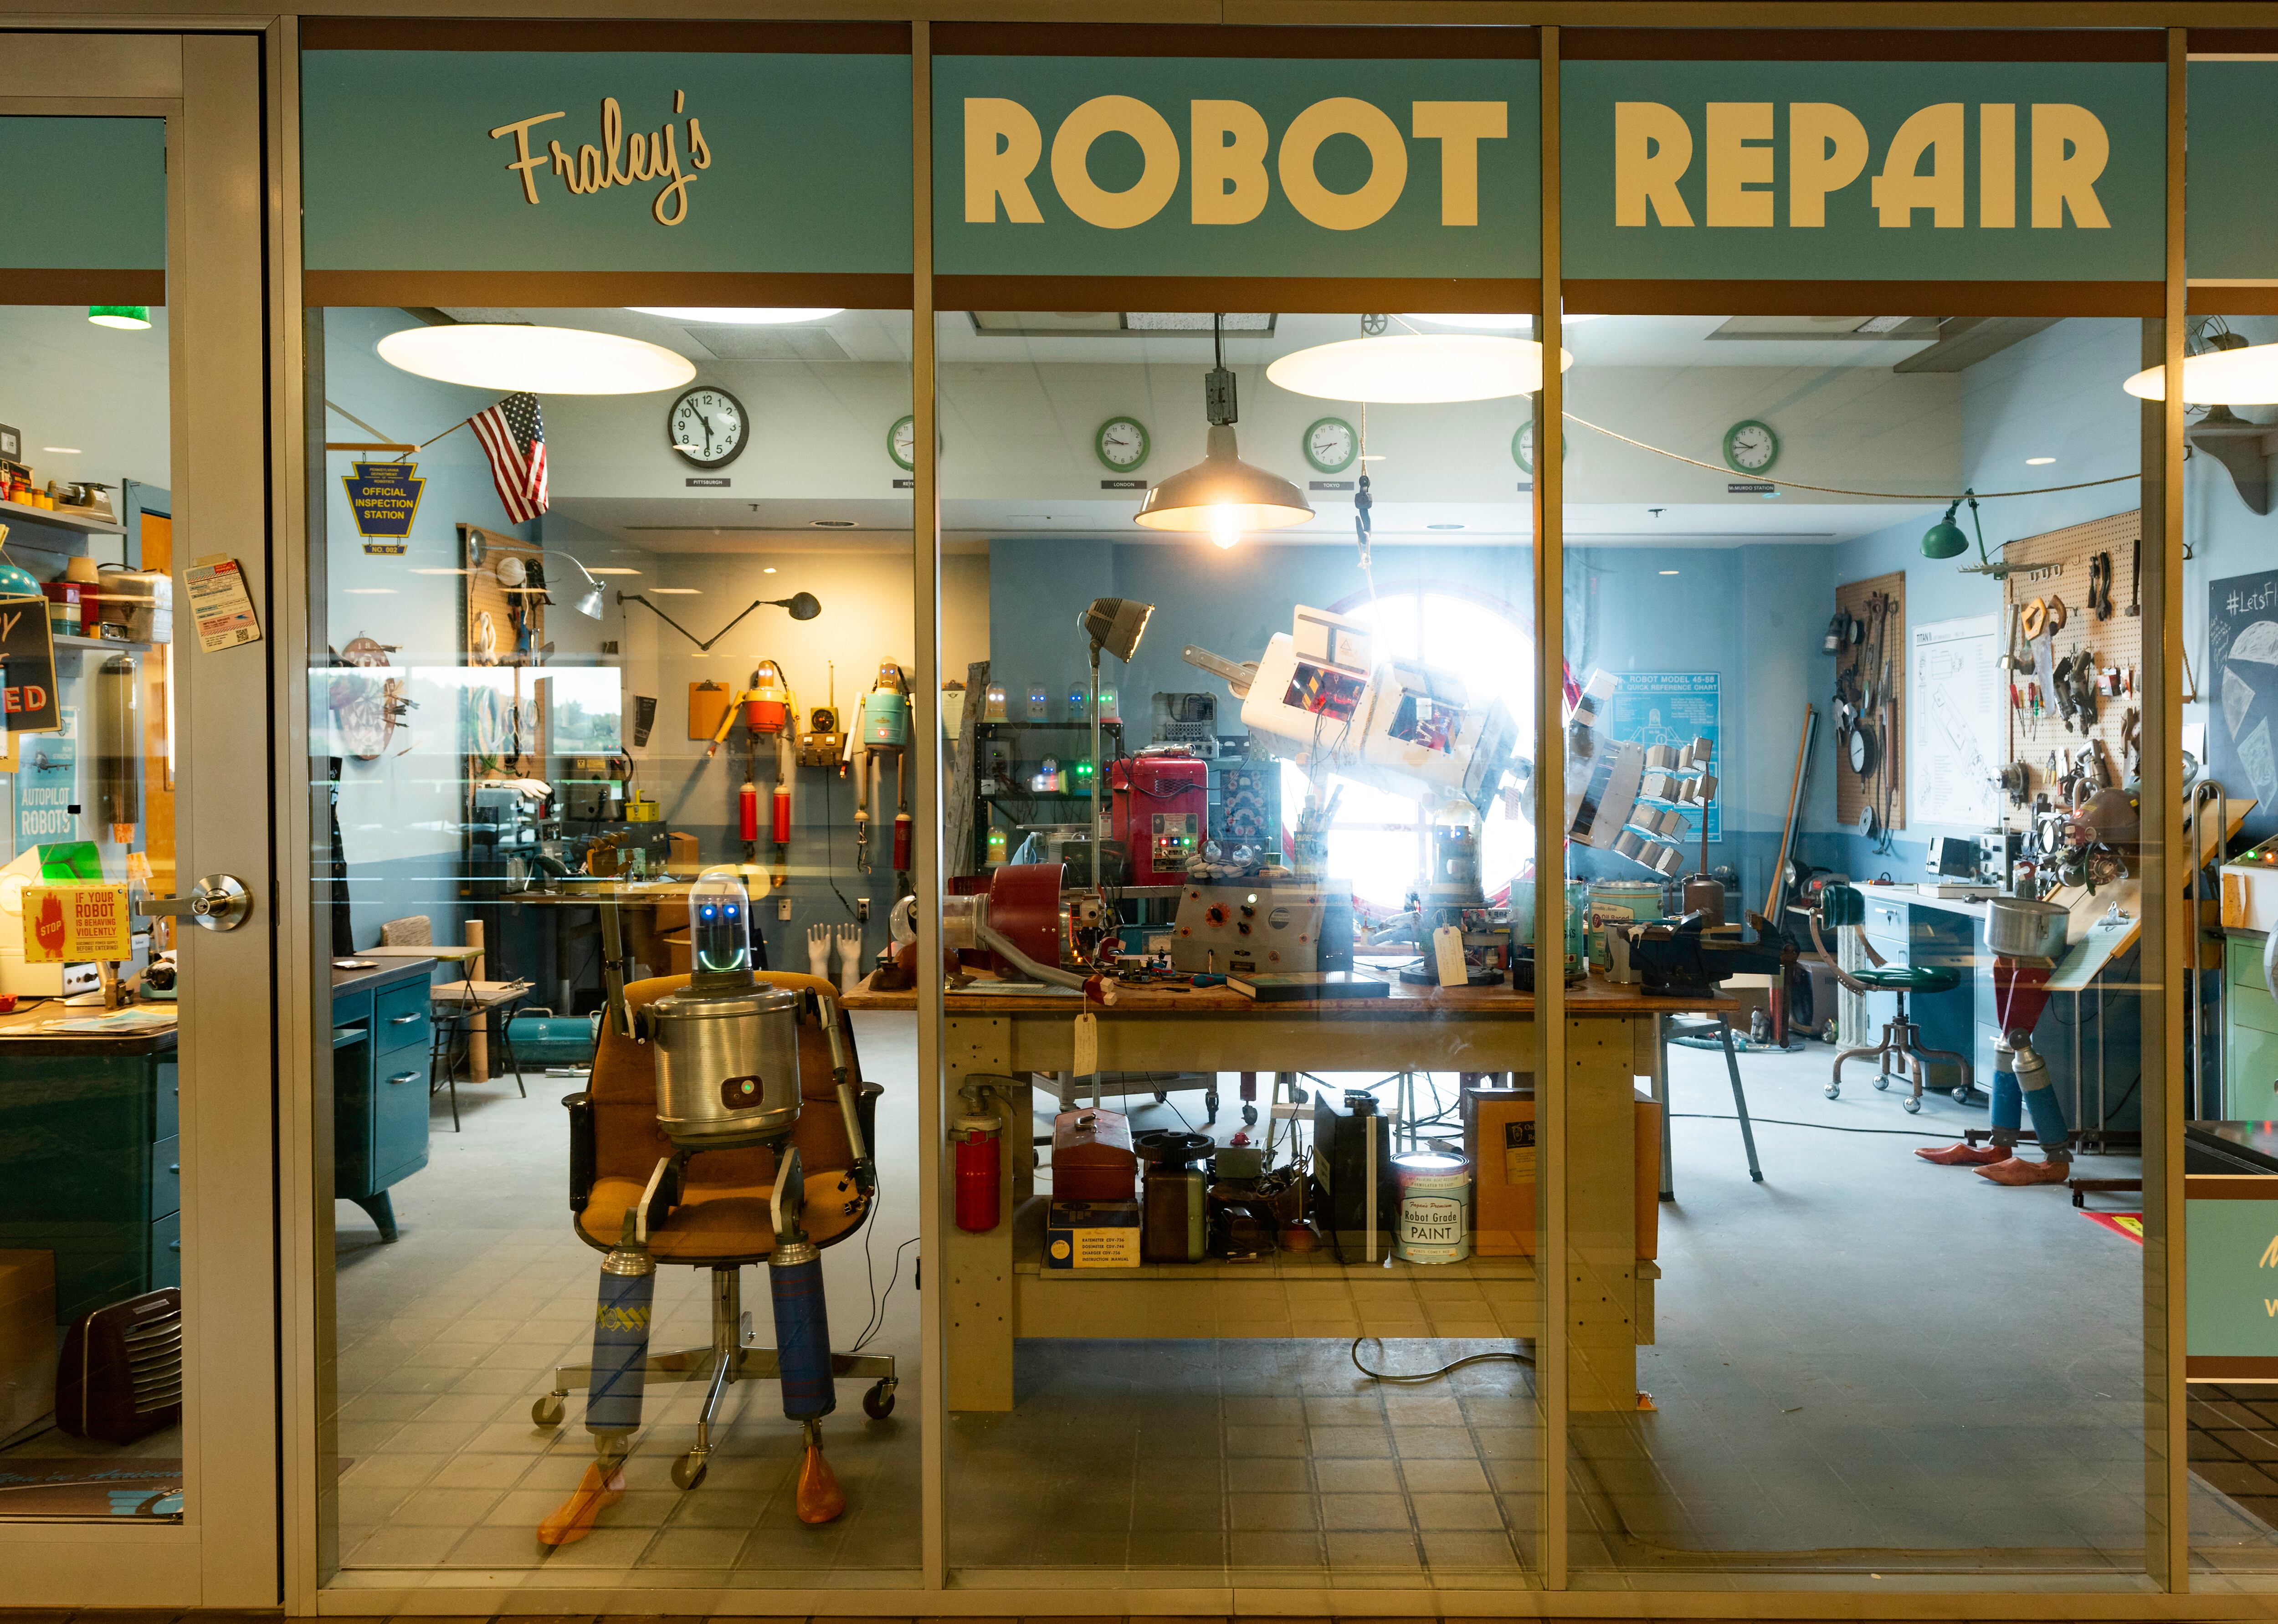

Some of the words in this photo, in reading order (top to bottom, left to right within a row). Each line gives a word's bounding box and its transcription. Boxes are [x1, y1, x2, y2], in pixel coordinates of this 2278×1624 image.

[488, 89, 711, 225] Fraley's
[965, 95, 1508, 231] ROBOT
[1615, 102, 2112, 228] REPAIR
[691, 398, 698, 407] 11
[703, 395, 712, 405] 12
[718, 399, 721, 407] 1
[681, 408, 691, 418] 10
[726, 408, 732, 416] 2
[678, 421, 685, 430] 9
[730, 422, 736, 431] 3
[682, 435, 689, 444] 8
[726, 435, 732, 444] 4
[704, 448, 710, 457] 6
[716, 445, 722, 454] 5
[363, 487, 406, 496] OFFICIAL
[355, 499, 413, 508] INSPECTION
[364, 511, 404, 519] STATION
[1917, 633, 1928, 643] TITAN
[22, 788, 70, 805] AUTOPILOT
[22, 809, 70, 835] ROBOTS
[76, 893, 84, 903] IF
[88, 892, 113, 903] YOUR
[76, 903, 114, 917] ROBOT
[41, 920, 62, 936] STOP
[77, 927, 116, 936] VIOLENTLY
[1405, 1210, 1428, 1221] Robot
[1433, 1211, 1457, 1222] Grade
[1411, 1227, 1451, 1239] PAINT
